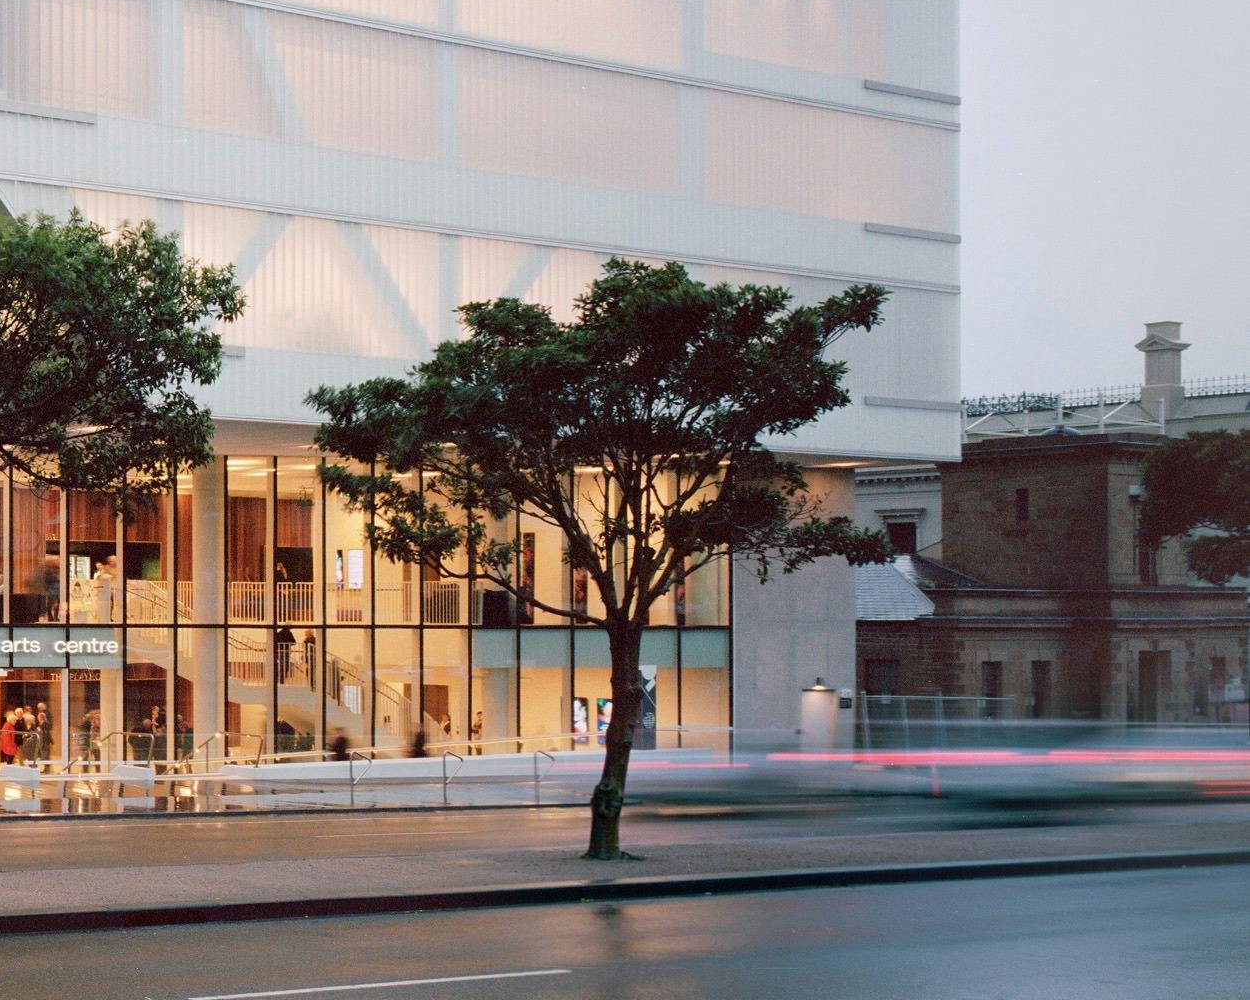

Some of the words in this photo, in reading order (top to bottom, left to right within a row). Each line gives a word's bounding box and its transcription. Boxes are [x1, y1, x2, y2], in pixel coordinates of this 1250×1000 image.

[0, 637, 41, 653] arts
[54, 637, 119, 654] centre
[70, 672, 101, 680] PLAYHO
